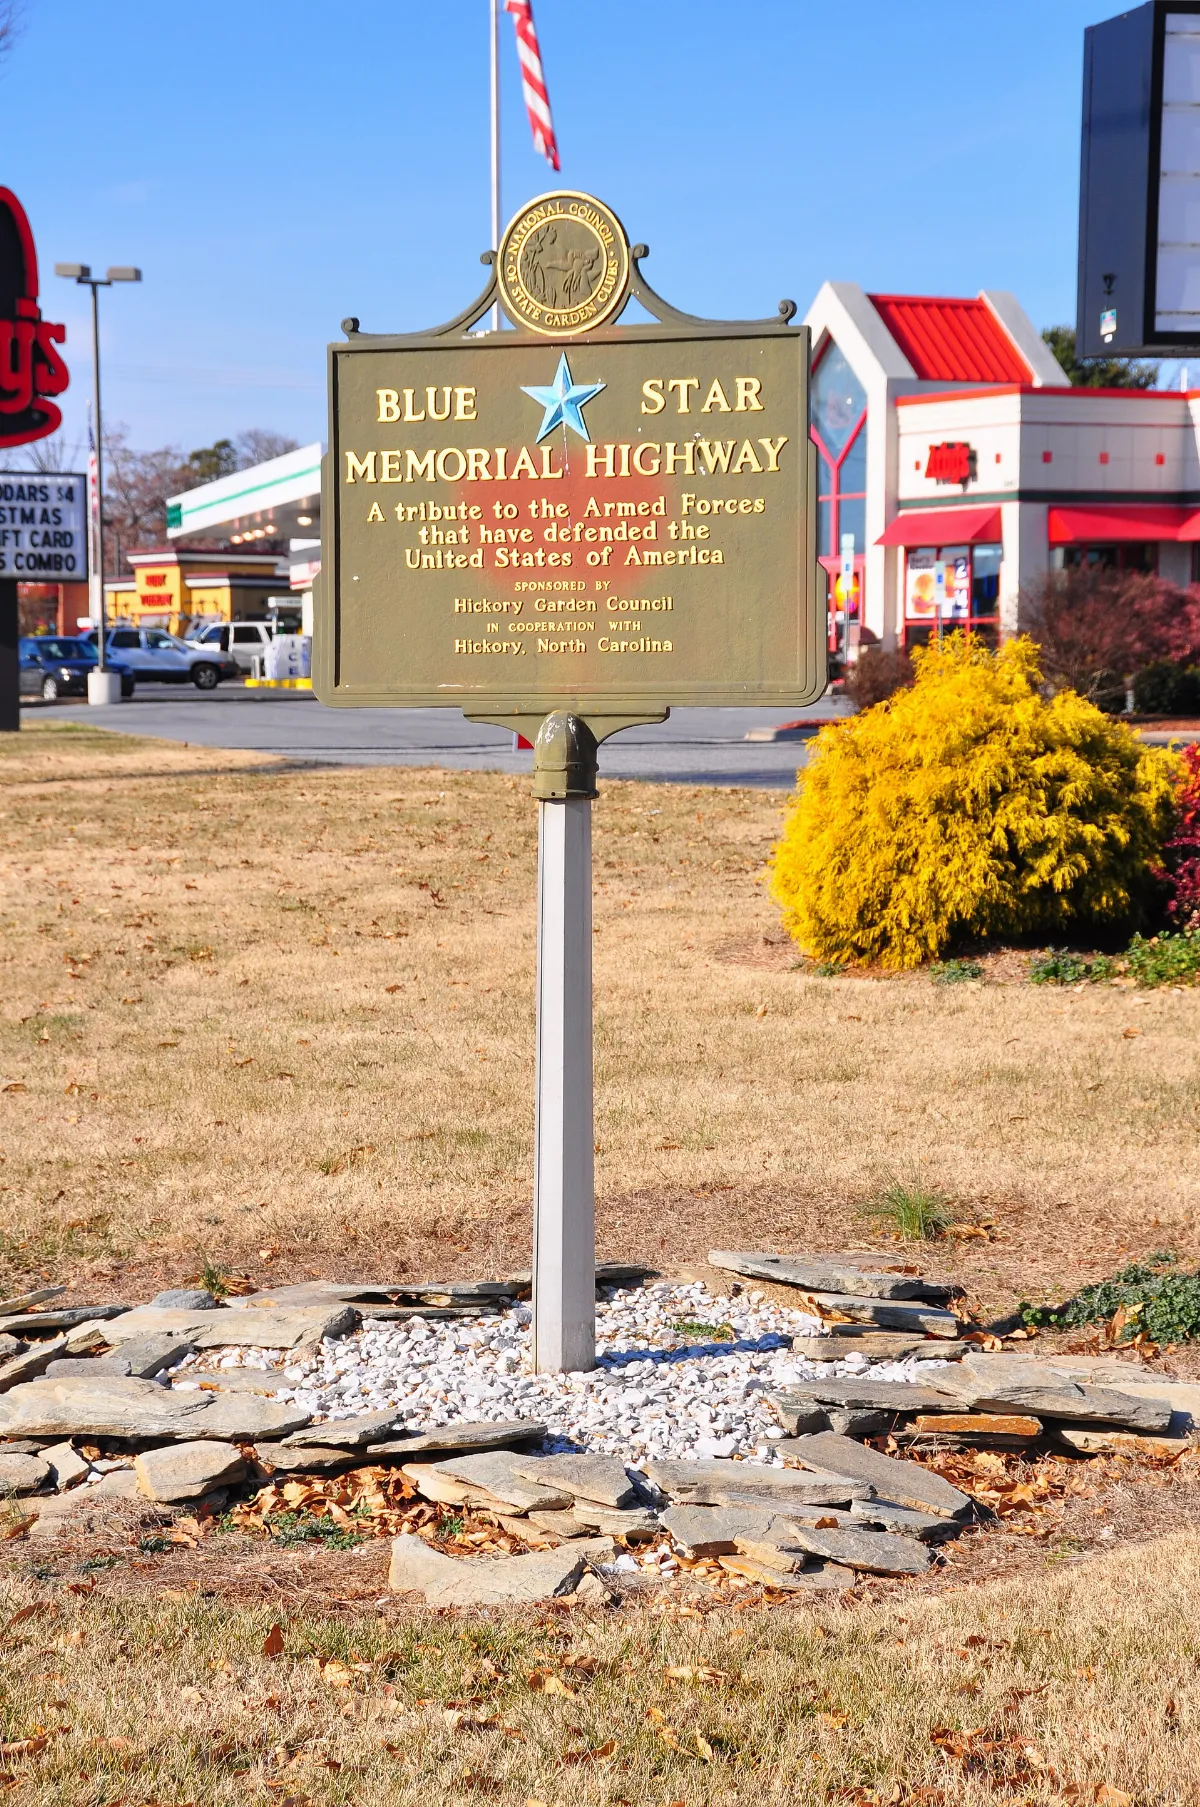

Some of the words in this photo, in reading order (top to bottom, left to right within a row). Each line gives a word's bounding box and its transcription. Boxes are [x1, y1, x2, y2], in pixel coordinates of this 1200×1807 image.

[507, 201, 564, 256] NATIONAL
[569, 203, 616, 249] COUNCIL
[506, 264, 518, 284] OF
[597, 259, 619, 302] CLUBS
[511, 286, 542, 321] STATE
[544, 302, 598, 327] GARDEN
[376, 386, 478, 423] BLUE
[641, 377, 765, 415] STAR
[345, 445, 564, 484] MEMORIAL
[584, 436, 790, 478] HIGHWAY
[57, 486, 75, 503] $4
[366, 501, 386, 522] A
[394, 500, 483, 522] tribute
[492, 500, 519, 520] to
[527, 498, 570, 519] the
[583, 496, 667, 518] Armed
[681, 493, 766, 515] Forces
[30, 530, 74, 548] CARD
[418, 524, 470, 545] that
[479, 524, 534, 544] have
[543, 519, 658, 543] defended
[668, 519, 711, 540] the
[14, 552, 76, 572] COMBO
[404, 548, 484, 569] United
[494, 547, 573, 569] States
[586, 545, 613, 566] of
[623, 544, 725, 566] America
[514, 580, 587, 592] SPONSORED
[595, 580, 611, 591] BY
[454, 598, 524, 615] Hickory
[534, 598, 598, 612] Garden
[606, 596, 674, 611] Council
[486, 622, 500, 633] IN
[508, 621, 596, 632] COOPERATION
[608, 620, 642, 631] WITH
[454, 638, 527, 656] Hickory,
[537, 638, 587, 653] North
[597, 636, 674, 653] Carolina
